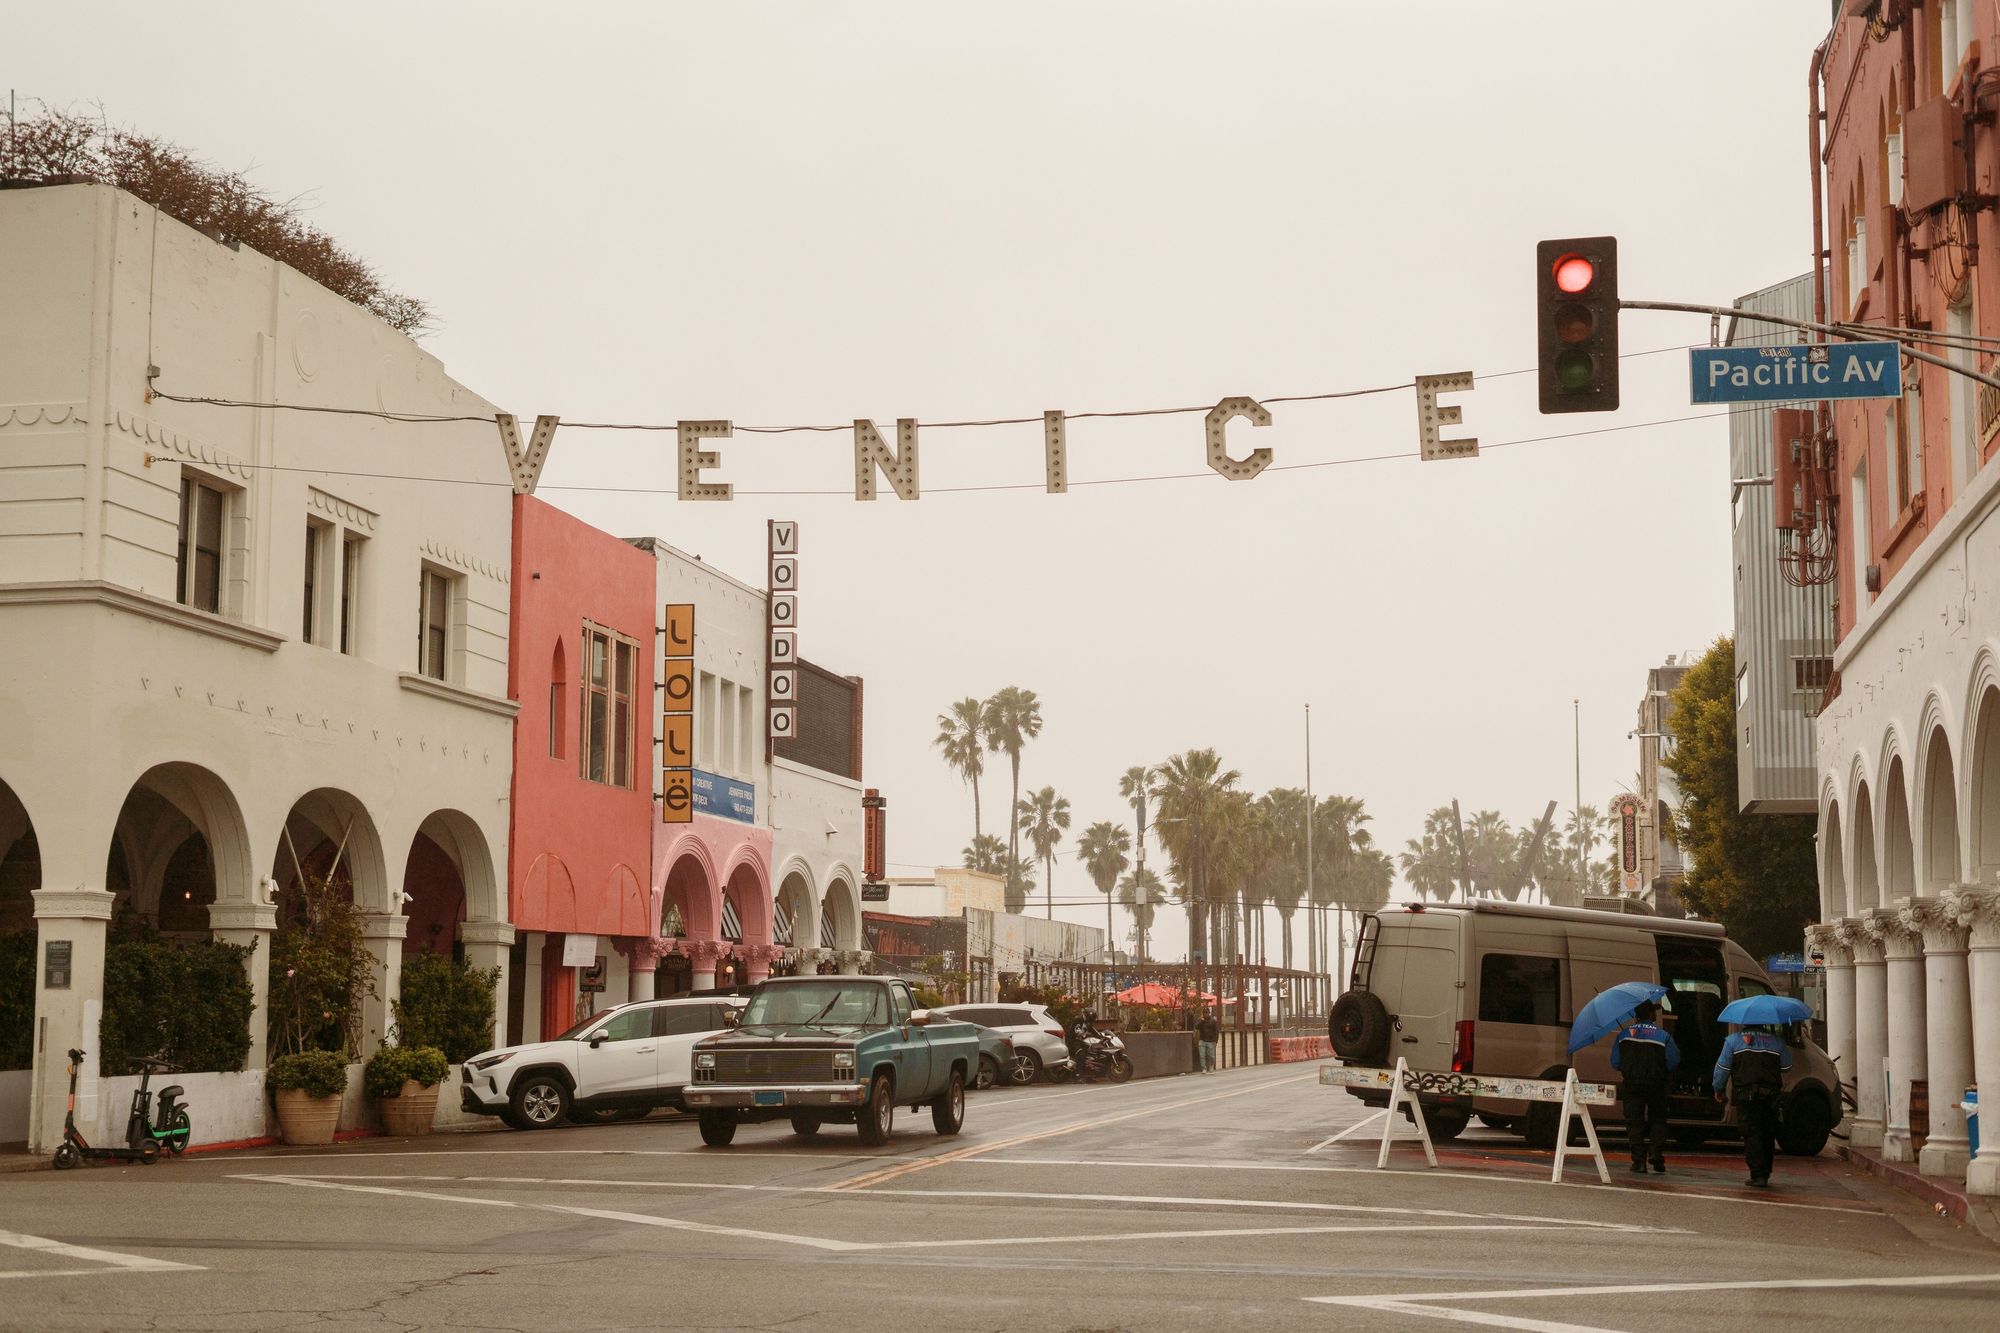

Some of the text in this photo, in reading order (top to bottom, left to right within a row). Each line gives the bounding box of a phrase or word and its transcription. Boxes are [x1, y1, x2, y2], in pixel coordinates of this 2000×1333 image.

[494, 369, 1479, 502] VENICE
[1708, 354, 1885, 388] Pacific Av
[773, 527, 792, 734] VOODOO
